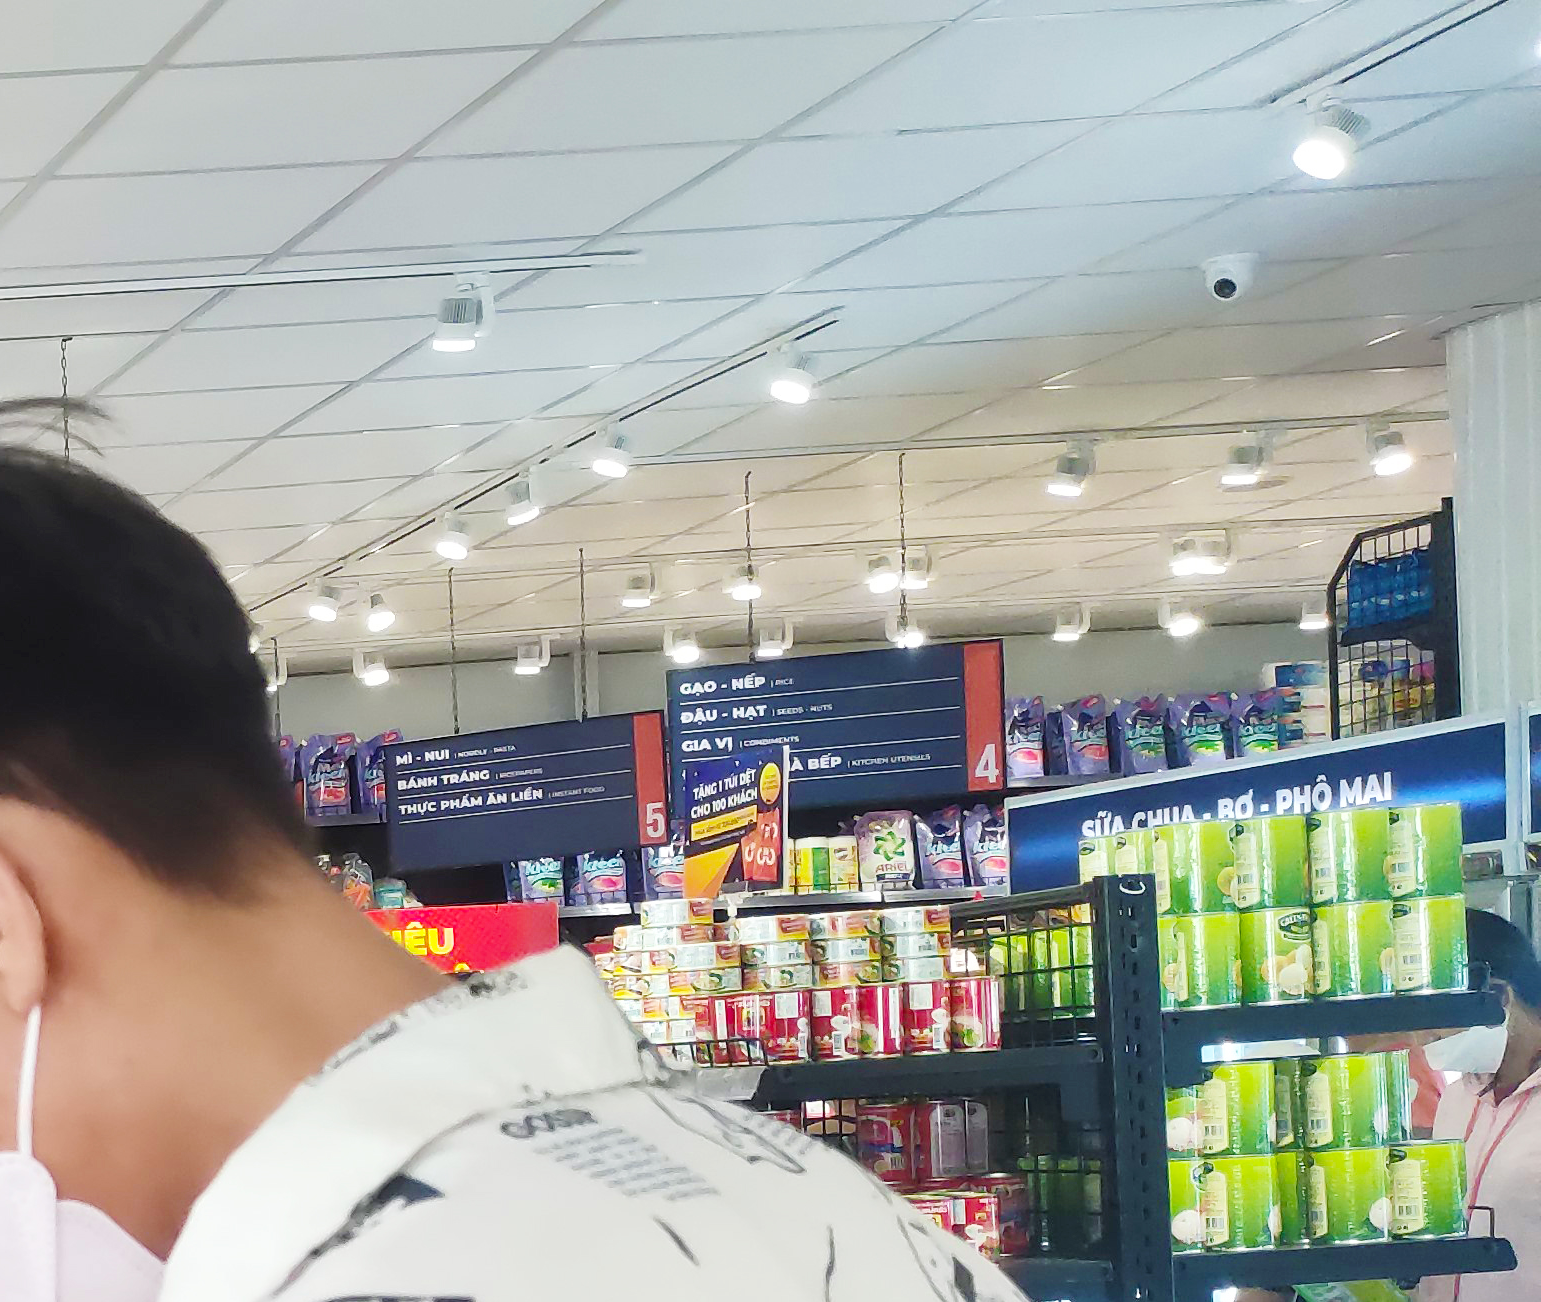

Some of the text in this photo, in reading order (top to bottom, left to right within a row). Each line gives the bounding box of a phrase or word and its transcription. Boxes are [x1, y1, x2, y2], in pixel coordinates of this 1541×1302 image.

[679, 680, 717, 698] GẠO
[731, 672, 766, 691] NẾP
[680, 706, 718, 725] ĐẬU
[733, 704, 768, 721] HẠT
[681, 736, 712, 753] GIA
[714, 736, 733, 752] VỊ
[396, 751, 413, 767] MÌ
[424, 749, 450, 763] NUI
[807, 752, 842, 771] BẾP
[975, 743, 1000, 784] 4
[397, 769, 490, 791] BÁNH TRÁNG
[398, 799, 438, 817] THỰC
[486, 791, 507, 806] ĂN
[690, 787, 758, 819] CHO 100 KHÁCH
[1275, 774, 1334, 816] PHÔ
[1339, 771, 1392, 808] MAI
[645, 802, 666, 838] 5
